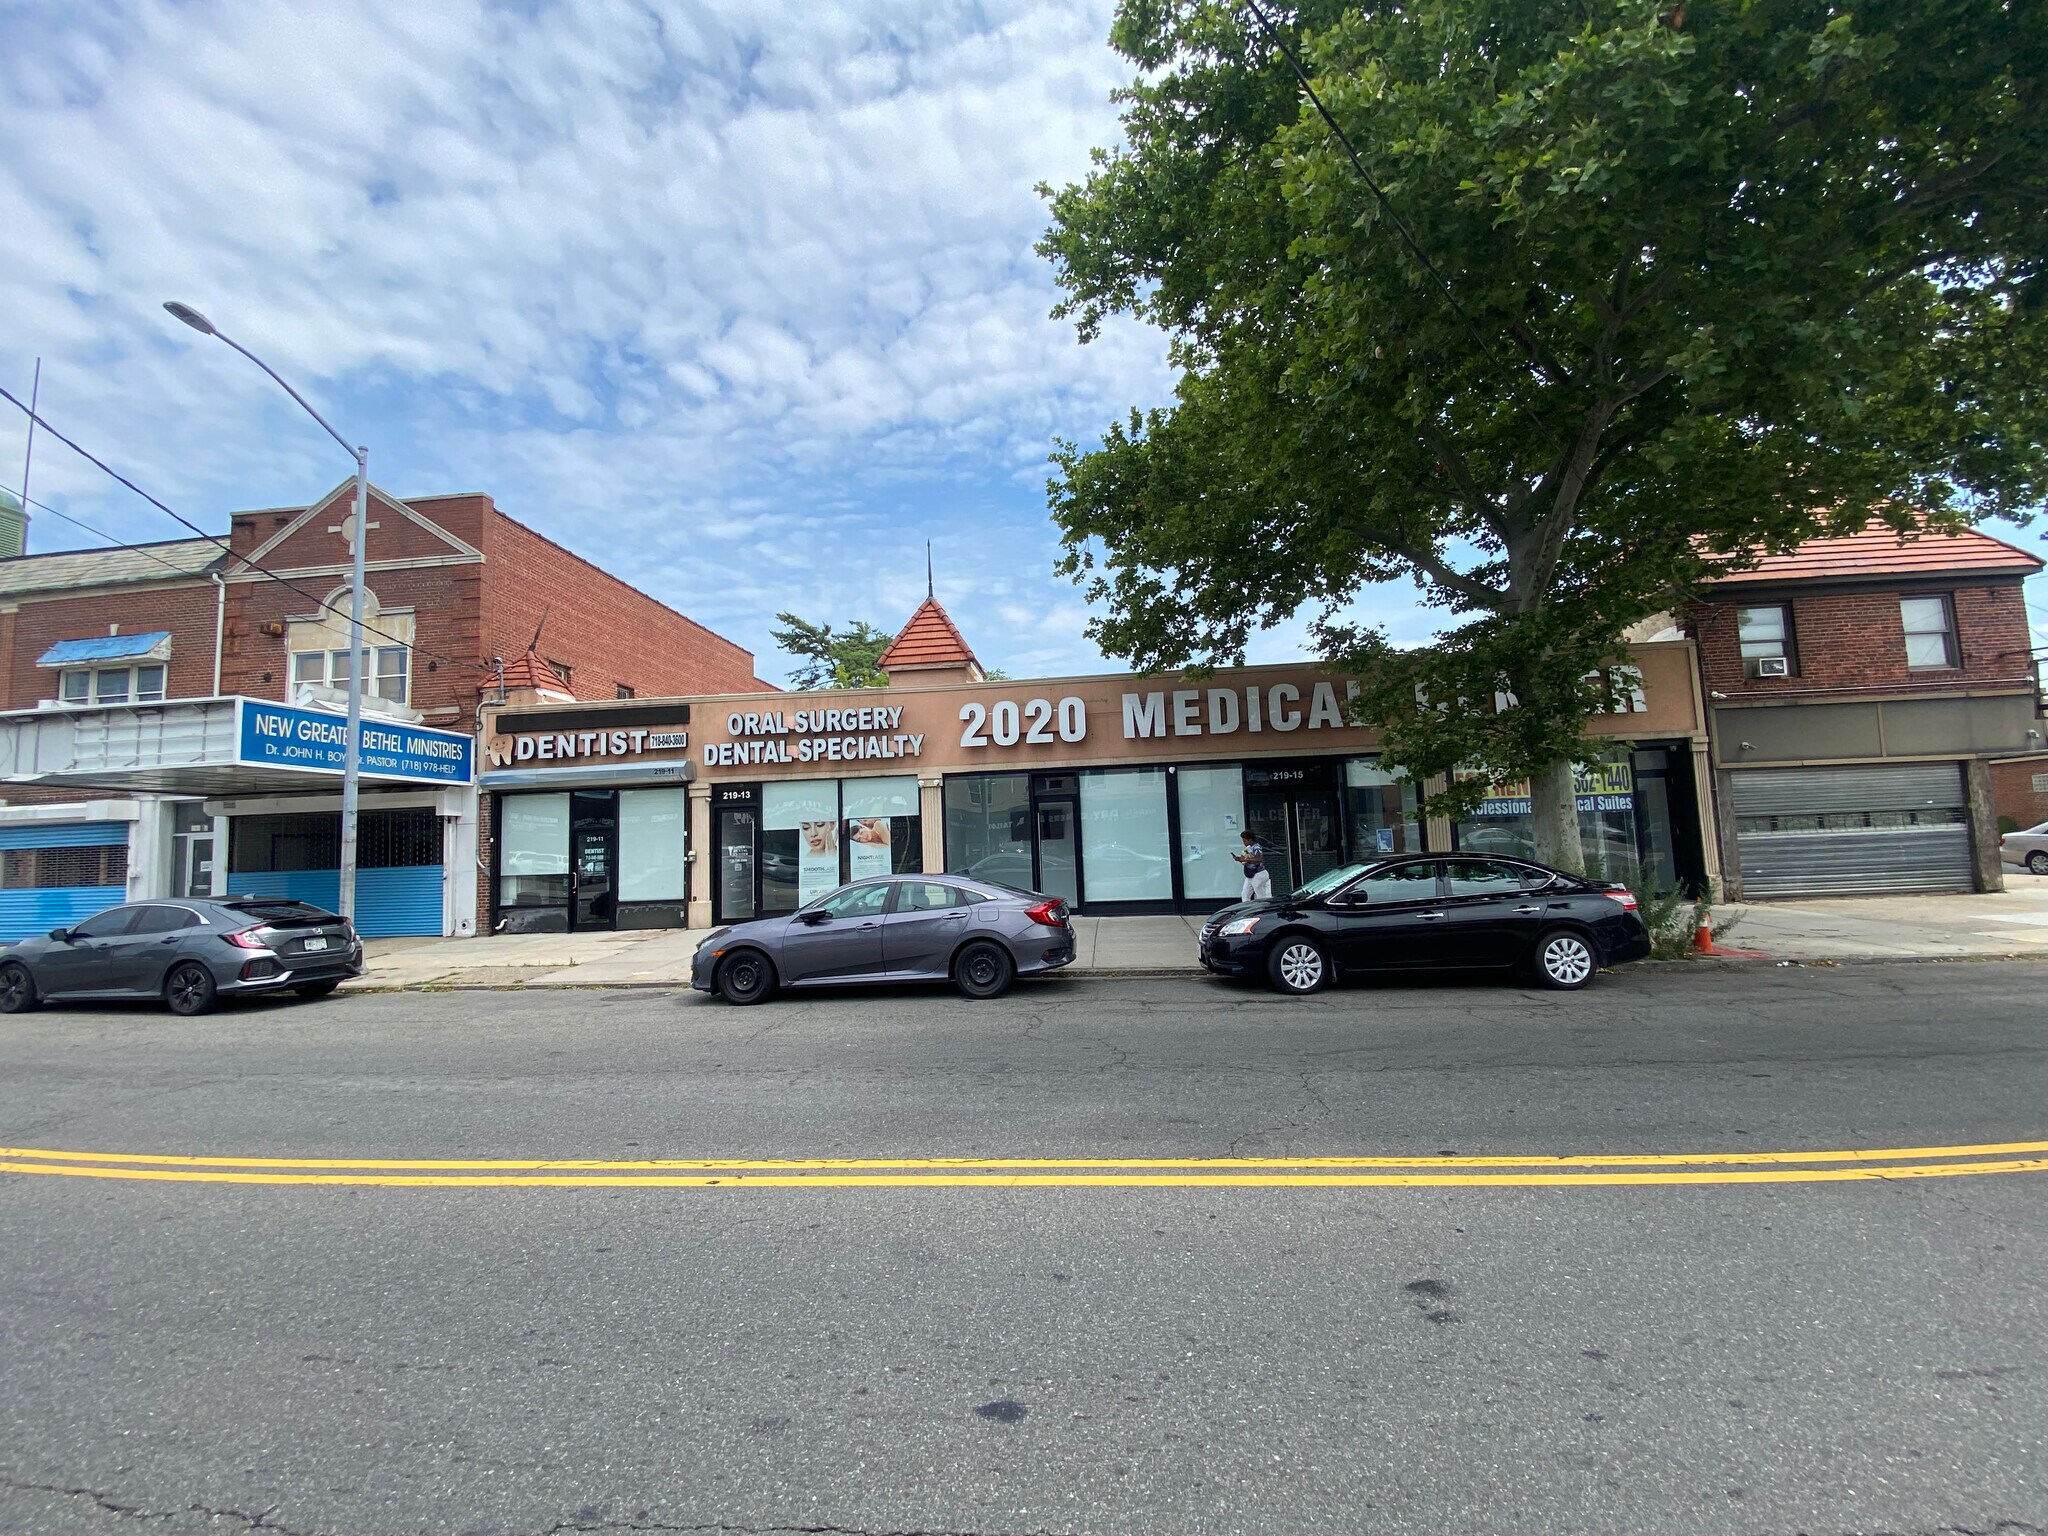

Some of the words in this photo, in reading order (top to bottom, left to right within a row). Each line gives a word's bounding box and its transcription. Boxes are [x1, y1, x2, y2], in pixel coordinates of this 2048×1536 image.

[727, 711, 789, 736] ORAL
[794, 706, 904, 734] SURGERY
[959, 696, 1087, 748] 2020
[255, 713, 295, 738] NEW
[297, 720, 348, 746] GREATE
[362, 730, 404, 753] BETHEL
[406, 736, 463, 761] MINISTRIES
[517, 730, 649, 760] DENTIST
[651, 734, 685, 747] 718-840-3600
[703, 740, 793, 767] DENTAL
[798, 733, 926, 762] SPECIALTY
[265, 743, 280, 755] Dr.
[282, 746, 313, 758] JOHN
[315, 750, 325, 760] H.
[327, 751, 347, 762] BOY
[366, 755, 397, 768] PASTOR
[401, 759, 421, 772] (718)
[423, 762, 456, 774] 978-HELP
[1273, 770, 1304, 781] 219-15
[722, 790, 751, 800] 219-13
[1597, 795, 1633, 811] Suites
